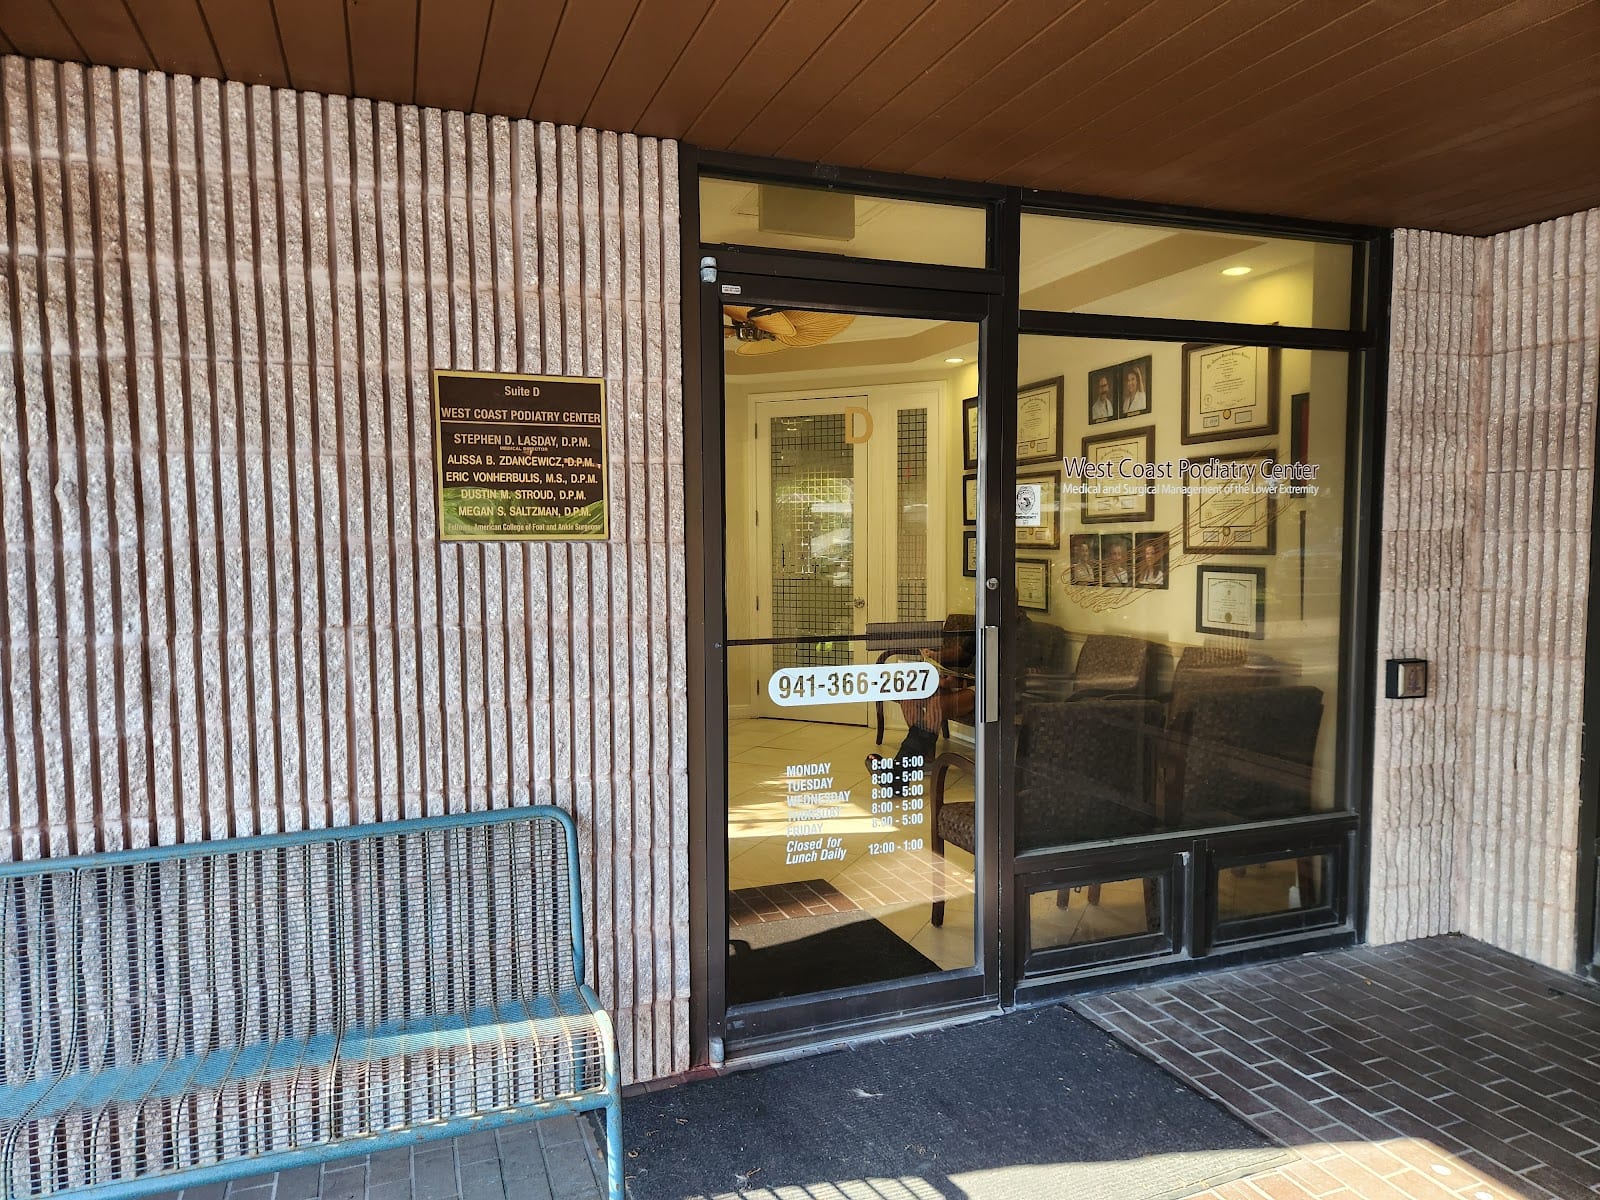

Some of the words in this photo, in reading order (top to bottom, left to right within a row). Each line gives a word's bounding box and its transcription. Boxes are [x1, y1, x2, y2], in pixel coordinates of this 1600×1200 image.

[504, 386, 530, 396] Suite
[533, 387, 540, 397] D
[441, 408, 471, 418] WEST
[474, 408, 508, 420] COAST
[511, 410, 560, 422] PODIATRY
[563, 412, 600, 423] CENTER
[844, 406, 874, 445] D
[454, 434, 500, 445] STEPHEN
[504, 435, 514, 446] D.
[518, 436, 558, 448] LASDAY,
[562, 437, 590, 447] D.P.M.
[448, 454, 482, 465] ALISSA
[486, 456, 495, 466] B.
[500, 456, 564, 468] ZDANCEWICZ,
[446, 472, 469, 482] ERIC
[473, 472, 542, 484] VONHERBULIS,
[546, 474, 568, 484] M.S.,
[570, 474, 598, 484] D.P.M.
[1063, 457, 1114, 478] West
[1120, 458, 1172, 480] Coast
[1179, 457, 1256, 484] Podiatry
[1260, 459, 1320, 480] Center
[461, 490, 497, 499] DUSTIN
[500, 490, 511, 499] M.
[515, 490, 556, 501] STROUD,
[560, 490, 586, 500] D.P.M.
[1062, 483, 1101, 494] Medical
[1103, 484, 1120, 494] and
[1122, 484, 1160, 496] Surgical
[1162, 484, 1222, 496] Management
[1225, 484, 1234, 494] of
[1235, 484, 1250, 494] the
[1252, 485, 1278, 494] Lower
[1280, 484, 1320, 496] Extremity
[458, 506, 494, 516] MEGAN
[498, 506, 506, 516] S.
[510, 506, 560, 518] SALTZMAN,
[564, 506, 591, 517] D.P.M.
[474, 523, 501, 531] American
[502, 524, 524, 532] College
[546, 523, 556, 531] and
[558, 523, 574, 531] Ankle
[778, 668, 930, 700] 941-366-2627
[786, 762, 831, 778] MONDAY
[872, 758, 894, 770] 8:00
[902, 755, 924, 768] 5:00
[787, 777, 834, 792] TUESDAY
[872, 772, 894, 785] 8:00
[902, 770, 924, 783] 5:00
[786, 790, 851, 807] WEDNESDAY
[872, 787, 894, 799] 8:00
[902, 784, 924, 797] 5:00
[872, 801, 894, 814] 8:00
[902, 798, 924, 811] 5:00
[786, 823, 824, 838] FRIDAY
[902, 813, 924, 825] 5:00
[786, 838, 823, 853] Closed
[826, 837, 842, 849] for
[868, 842, 895, 855] 12:00
[904, 838, 924, 851] 1:00
[786, 850, 817, 865] Lunch
[820, 848, 847, 861] Daily
